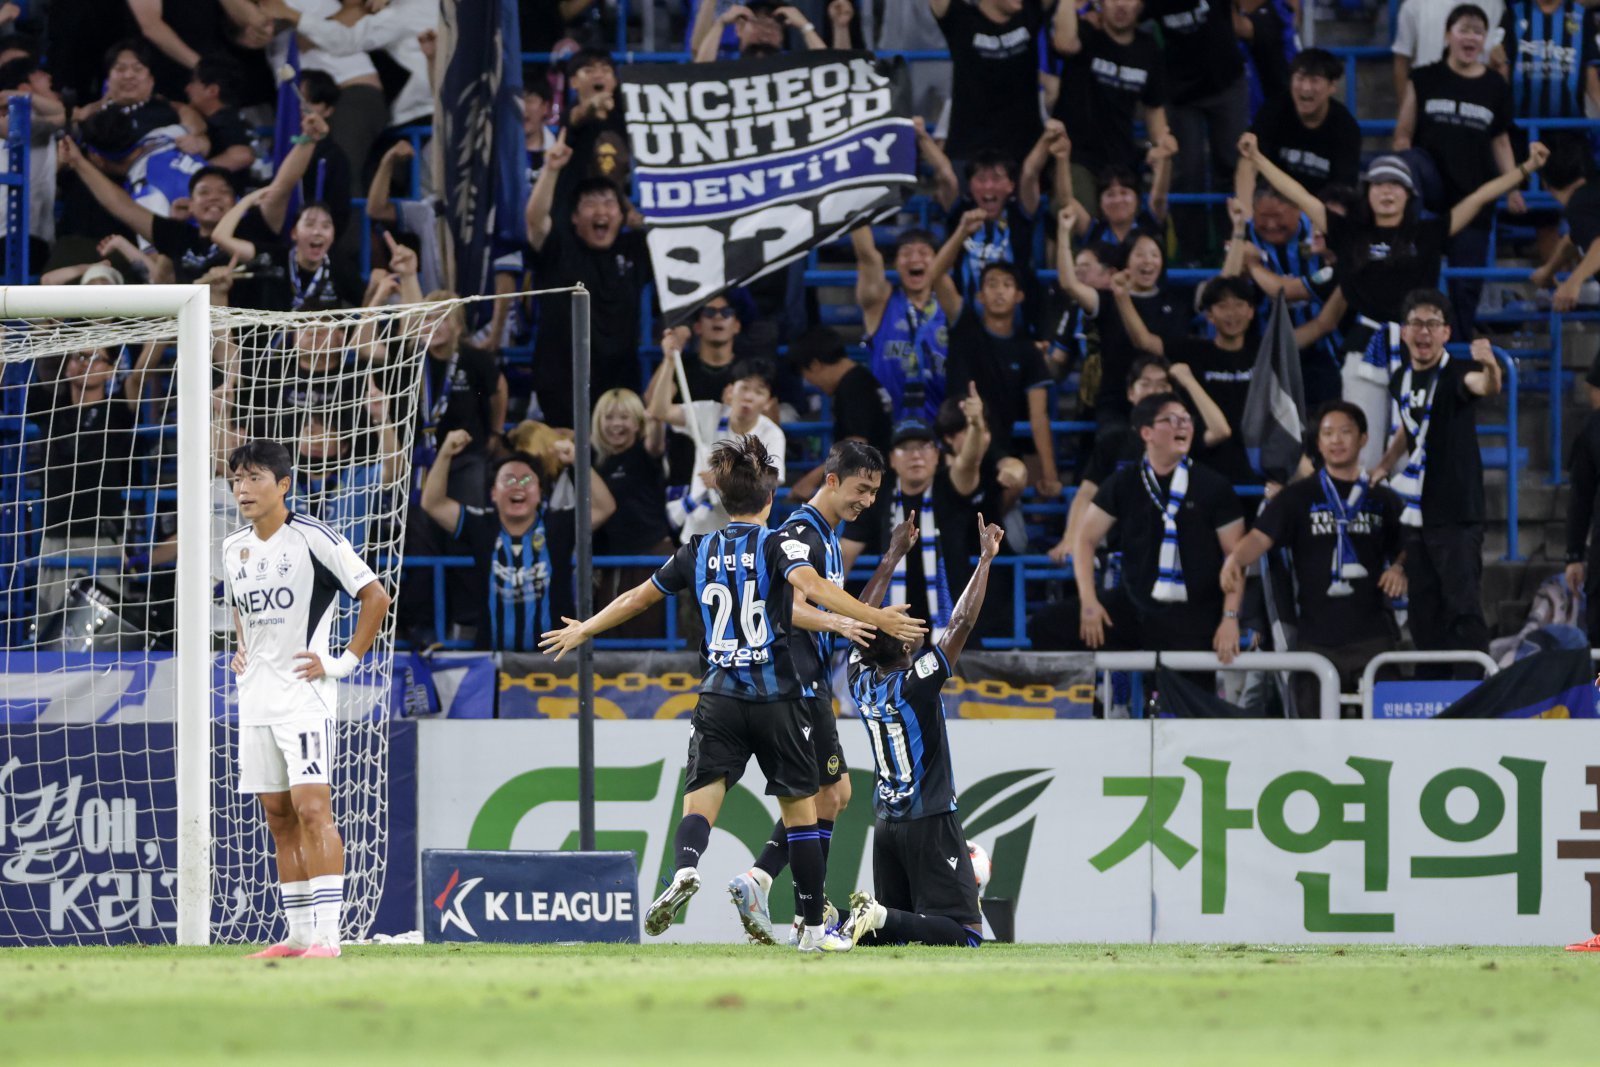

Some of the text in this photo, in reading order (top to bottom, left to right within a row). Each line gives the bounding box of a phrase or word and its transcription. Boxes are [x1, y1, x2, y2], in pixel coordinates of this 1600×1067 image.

[621, 58, 890, 123] INCHEON
[627, 88, 892, 165] UNITED
[708, 552, 755, 571] 이민혁
[237, 587, 295, 616] NEXO
[701, 580, 768, 651] 26
[298, 731, 321, 760] 11
[866, 718, 913, 783] 11
[485, 891, 634, 922] K LEAGUE
